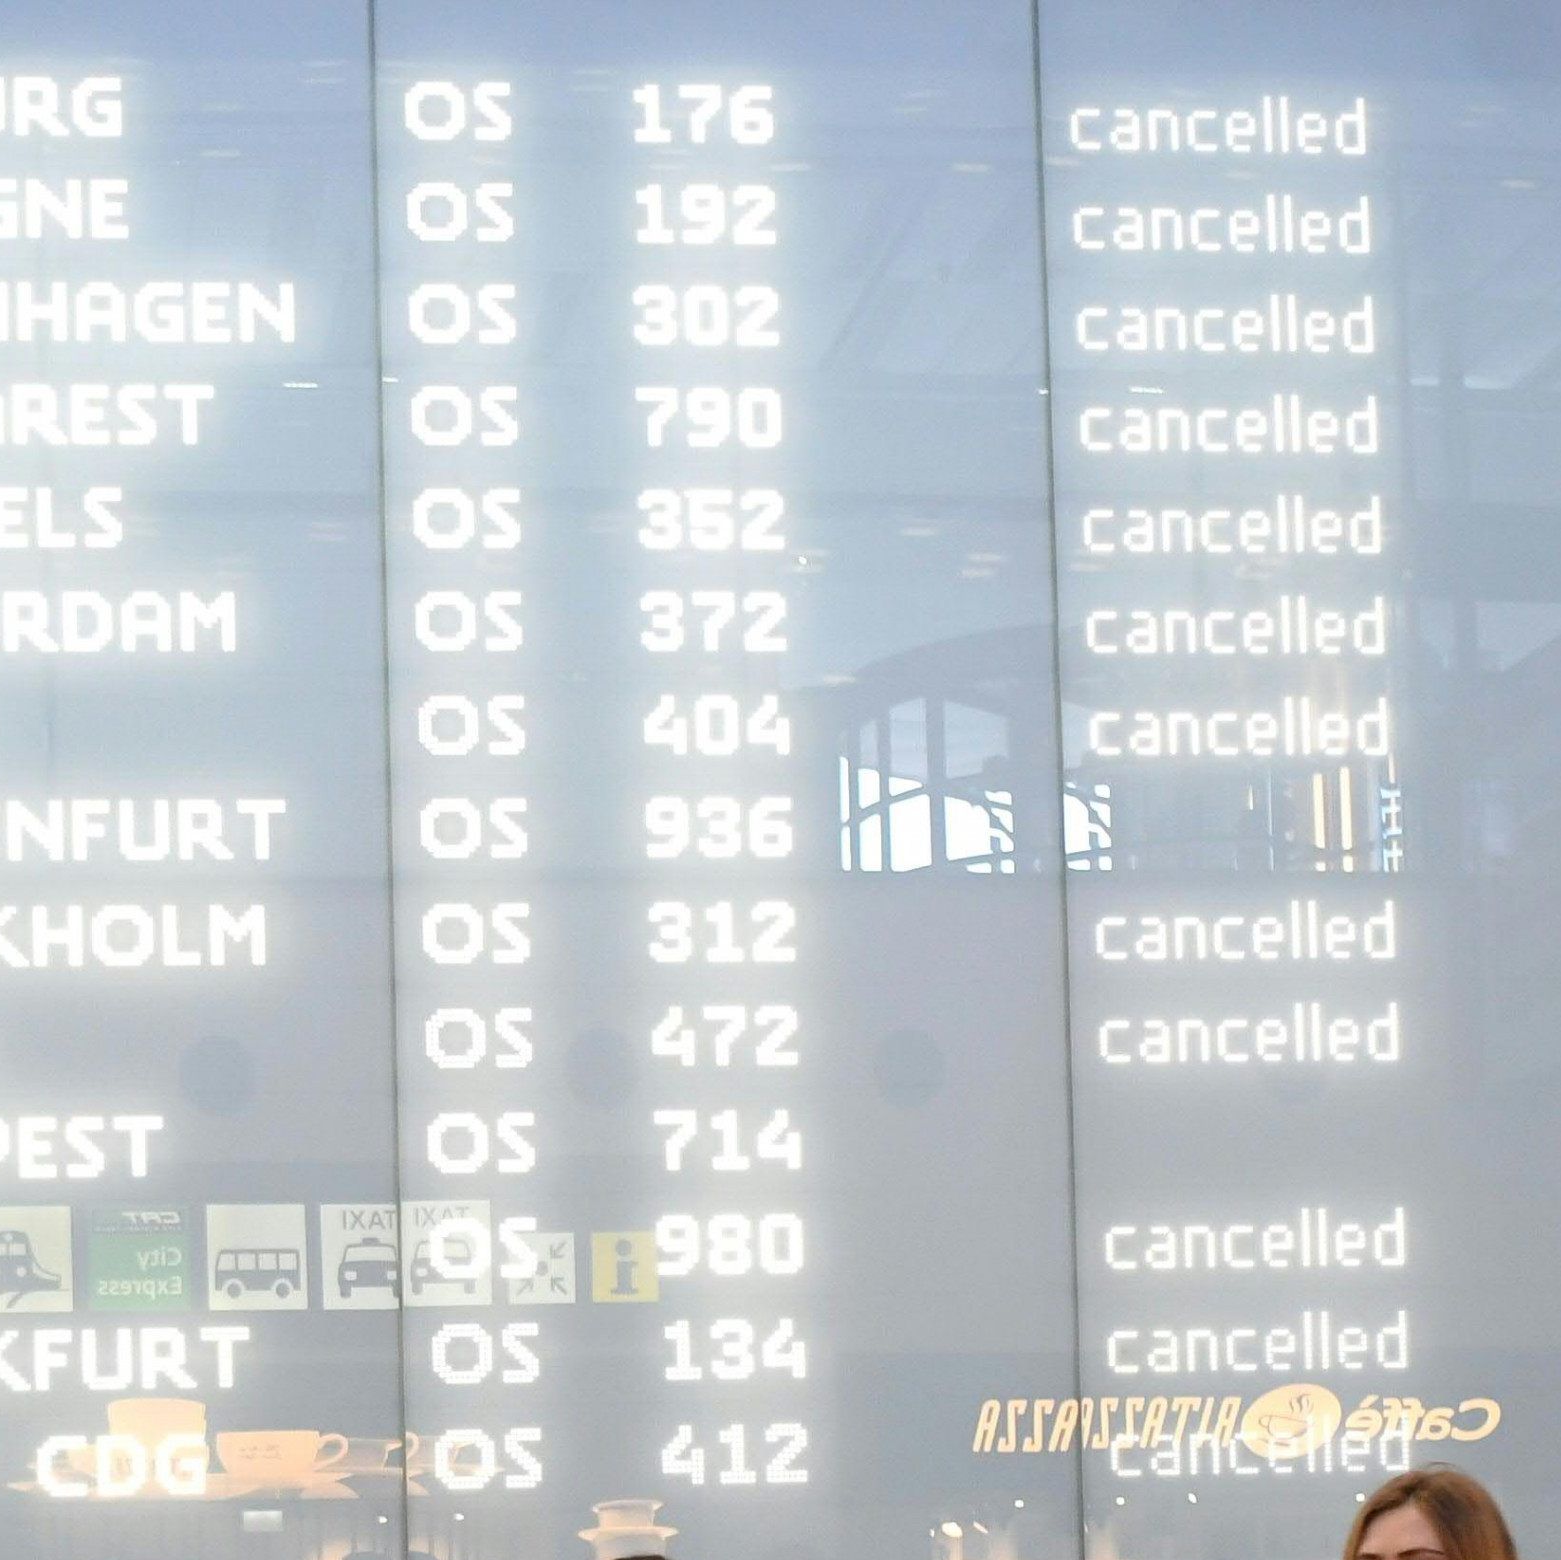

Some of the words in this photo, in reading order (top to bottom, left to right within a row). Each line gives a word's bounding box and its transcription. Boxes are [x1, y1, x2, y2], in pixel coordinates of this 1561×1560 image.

[405, 82, 511, 140] OS
[634, 85, 773, 143] 176
[1071, 97, 1366, 154] cancelled
[408, 183, 513, 241] OS
[637, 184, 776, 244] 192
[1074, 194, 1370, 253] cancelled
[409, 284, 515, 343] OS
[634, 285, 779, 346] 302
[1077, 294, 1374, 353] cancelled
[412, 386, 518, 445] OS
[636, 388, 781, 447] 790
[1080, 394, 1377, 453] cancelled
[414, 489, 520, 548] OS
[639, 488, 785, 549] 352
[1084, 495, 1382, 553] cancelled
[416, 592, 522, 651] OS
[641, 591, 786, 651] 372
[1087, 595, 1385, 654] cancelled
[419, 695, 525, 755] OS
[644, 695, 789, 755] 404
[1089, 696, 1391, 756] cancelled
[421, 798, 527, 858] OS
[646, 796, 792, 858] 936
[423, 903, 530, 963] OS
[649, 901, 795, 962] 312
[1096, 900, 1395, 960] cancelled
[426, 1008, 532, 1068] OS
[652, 1006, 798, 1065] 472
[1100, 1002, 1399, 1063] cancelled
[428, 1113, 535, 1173] OS
[654, 1110, 800, 1170] 714
[429, 1217, 537, 1278] OS
[657, 1214, 803, 1275] 980
[1106, 1207, 1405, 1269] cancelled
[433, 1324, 538, 1383] OS
[665, 1319, 805, 1380] 134
[1108, 1311, 1407, 1373] cancelled
[37, 1436, 204, 1496] CDG
[436, 1428, 541, 1489] OS
[663, 1424, 807, 1484] 412
[1111, 1415, 1409, 1476] cancelled
